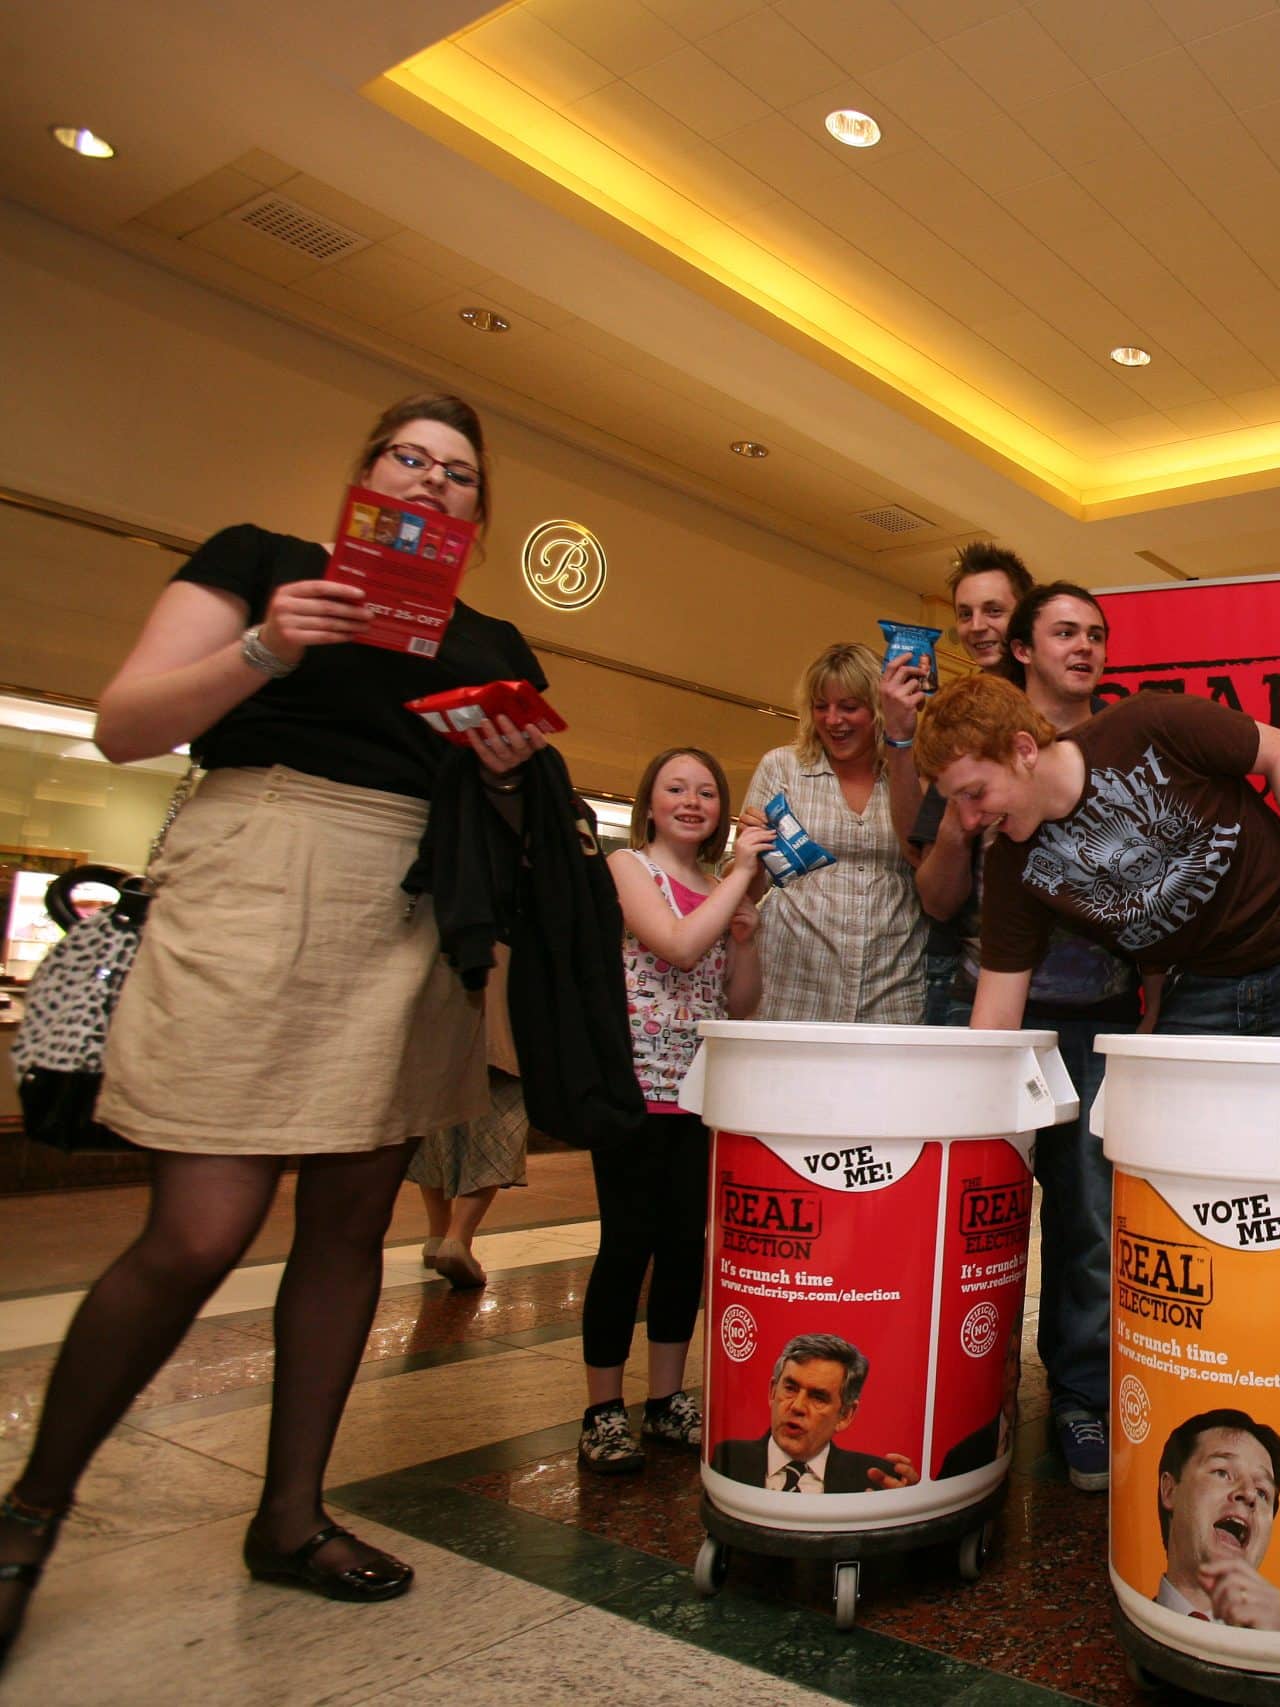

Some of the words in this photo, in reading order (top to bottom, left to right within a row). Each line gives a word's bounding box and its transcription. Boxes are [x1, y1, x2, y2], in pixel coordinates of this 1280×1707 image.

[804, 1145, 874, 1174] VOTE
[843, 1161, 893, 1188] ME!
[723, 1190, 814, 1233] REAL
[1193, 1194, 1272, 1226] VOTE
[723, 1231, 812, 1260] ELECTION
[721, 1258, 737, 1276] It's
[739, 1266, 790, 1286] crunch
[794, 1271, 834, 1287] time
[960, 1264, 982, 1280] It's
[1118, 1238, 1204, 1297] REAL
[721, 1278, 900, 1303] www.realcrisps.com/election
[1118, 1286, 1204, 1331] ELECTION
[974, 1322, 989, 1337] NO
[1133, 1329, 1182, 1357] crunch
[1186, 1344, 1229, 1365] time
